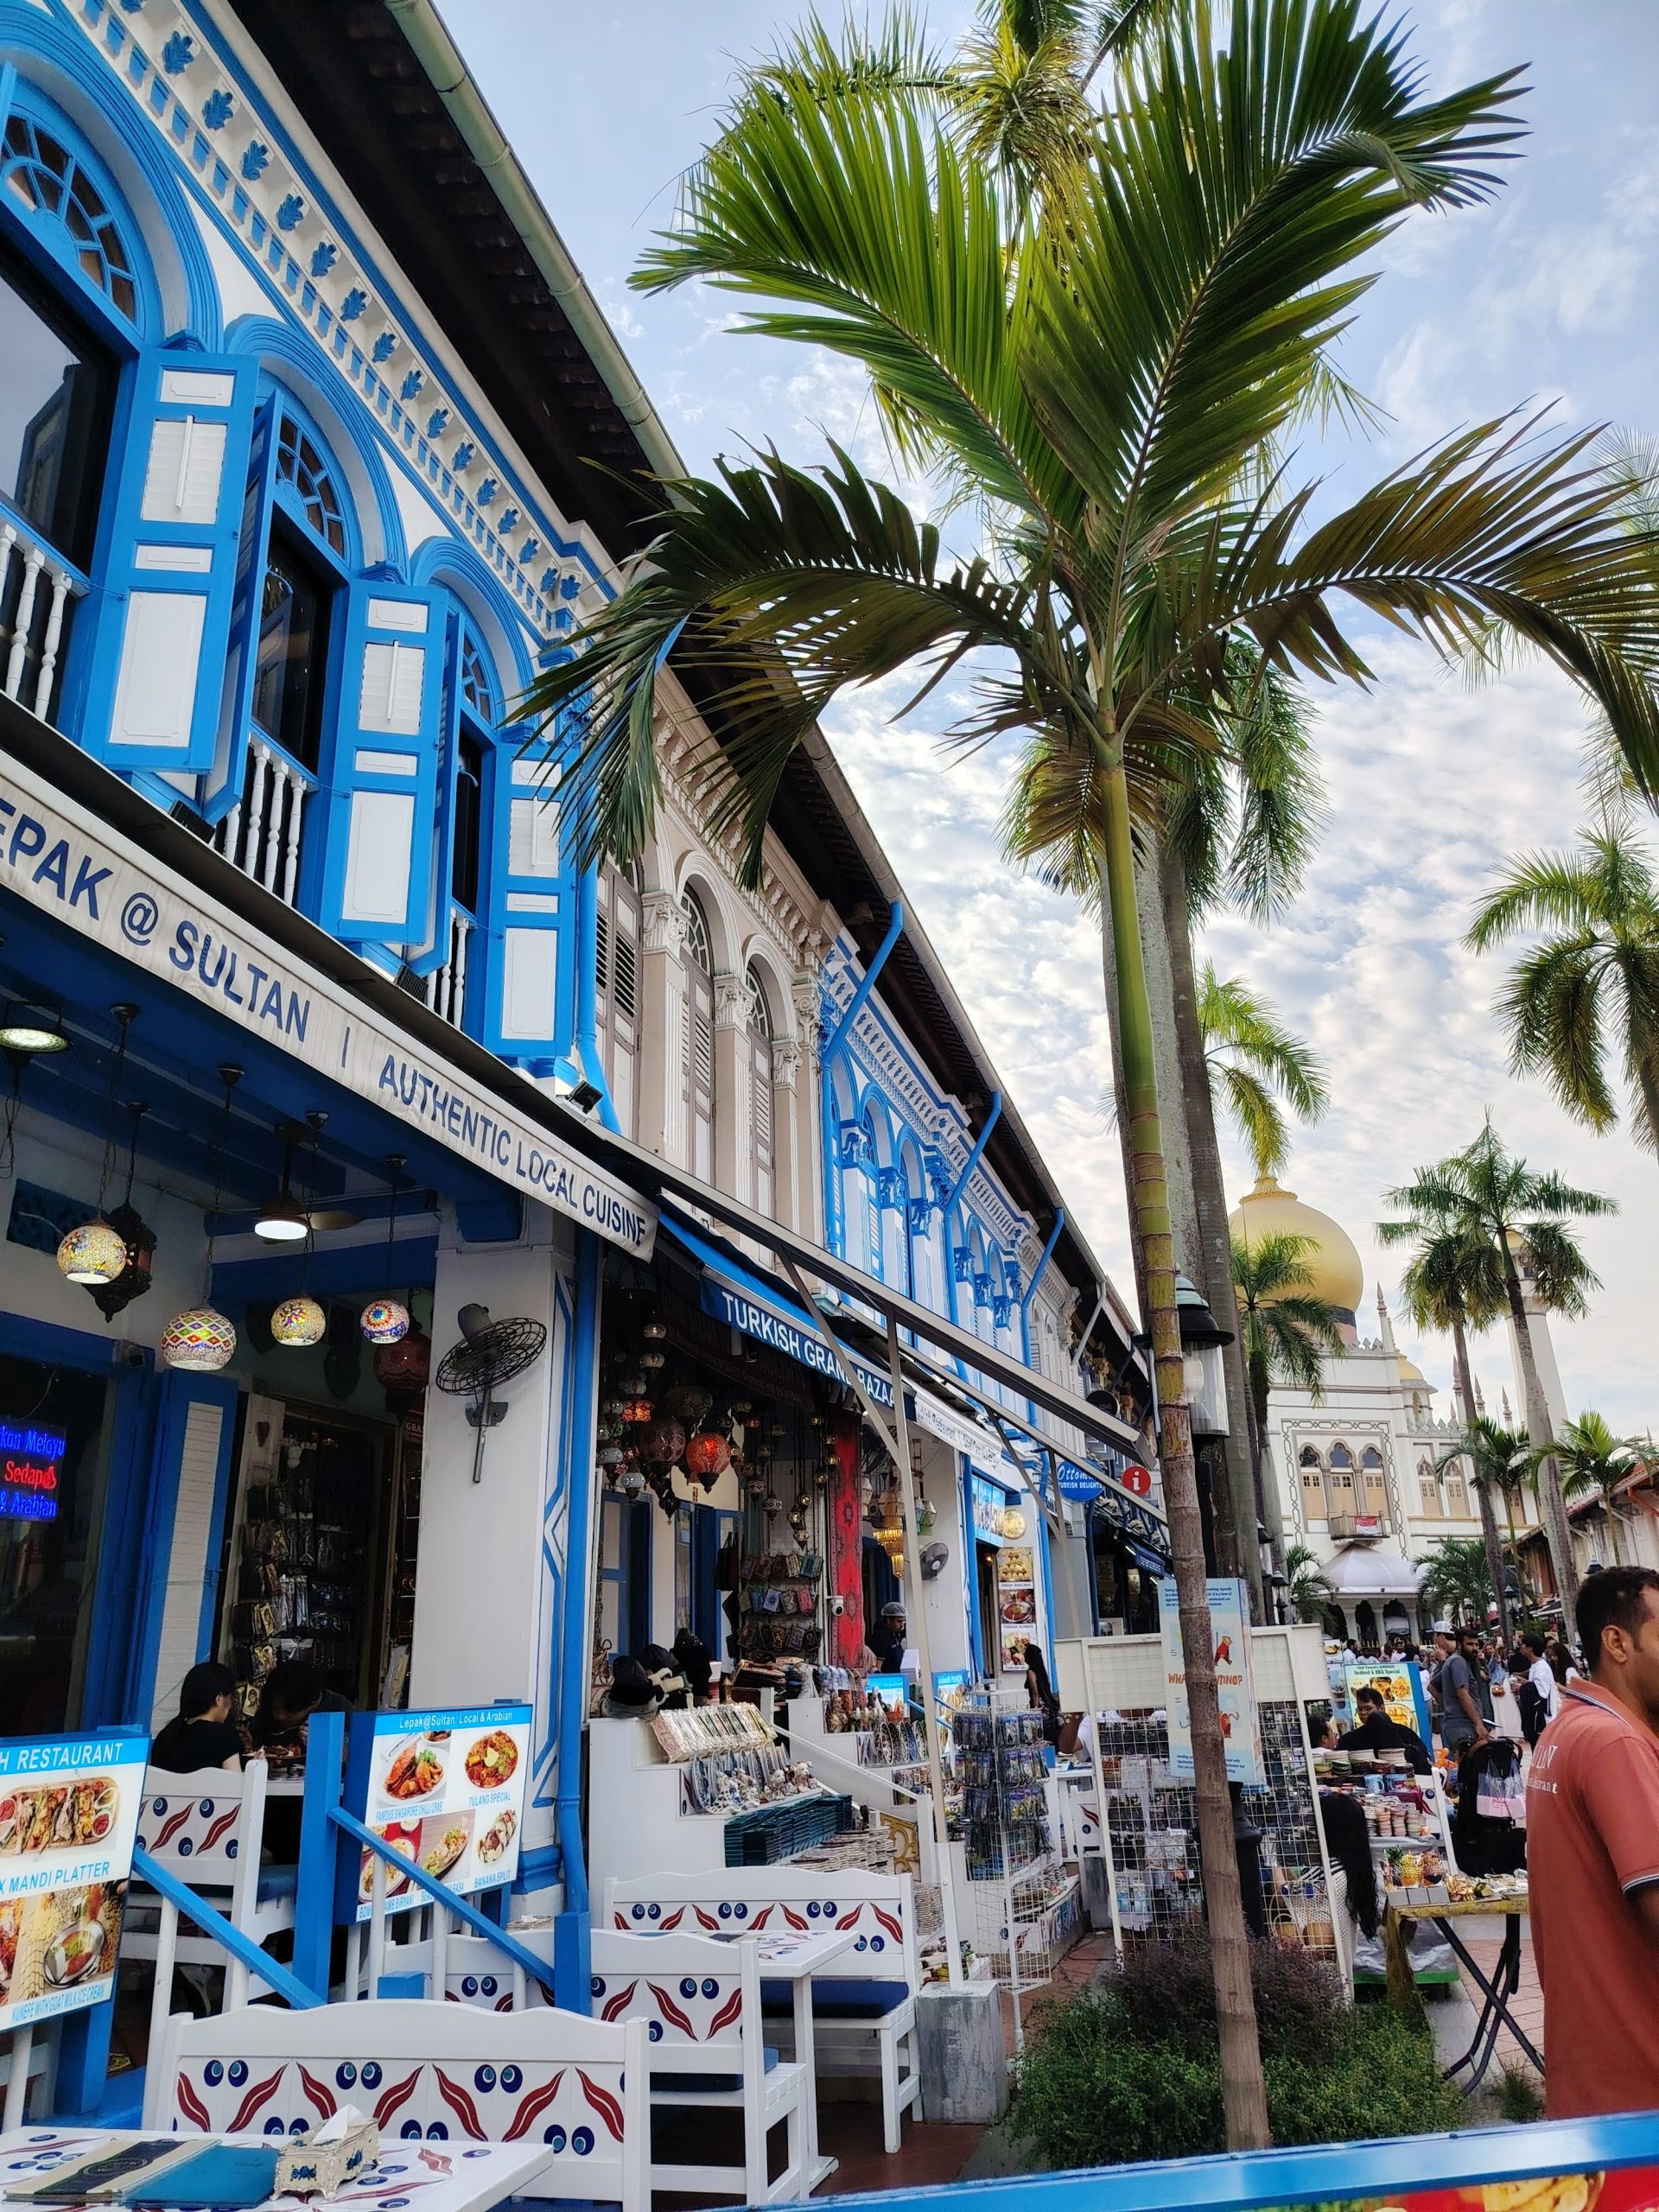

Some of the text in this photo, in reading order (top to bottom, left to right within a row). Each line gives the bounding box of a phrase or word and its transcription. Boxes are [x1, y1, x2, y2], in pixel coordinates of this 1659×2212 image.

[120, 892, 159, 946] @
[168, 920, 310, 1042] SULTAN
[378, 1054, 512, 1166] AUTHENTIC
[516, 1141, 578, 1209] LOCAL
[582, 1185, 645, 1247] CUISINE
[721, 1291, 802, 1359] TURKISH
[857, 1369, 894, 1408] BAZAA
[25, 1430, 66, 1460] Melayu
[10, 1491, 57, 1517] Arabian
[459, 1713, 479, 1725] Local
[480, 1713, 486, 1723] &
[486, 1711, 512, 1722] Arabian
[16, 1742, 124, 1770] RESTAURANT
[376, 1807, 394, 1821] FAMOUS
[393, 1804, 419, 1820] SINGAPORE
[432, 1801, 443, 1814] CRAB
[469, 1790, 512, 1807] TULANG SPECIAL
[9, 1870, 52, 1894] MANDI
[54, 1861, 110, 1886] PLATTER
[474, 1869, 512, 1888] BANANA SPLIT
[11, 1982, 105, 2023] KUNEFE WITH GOAT MILK ICE CREAM
